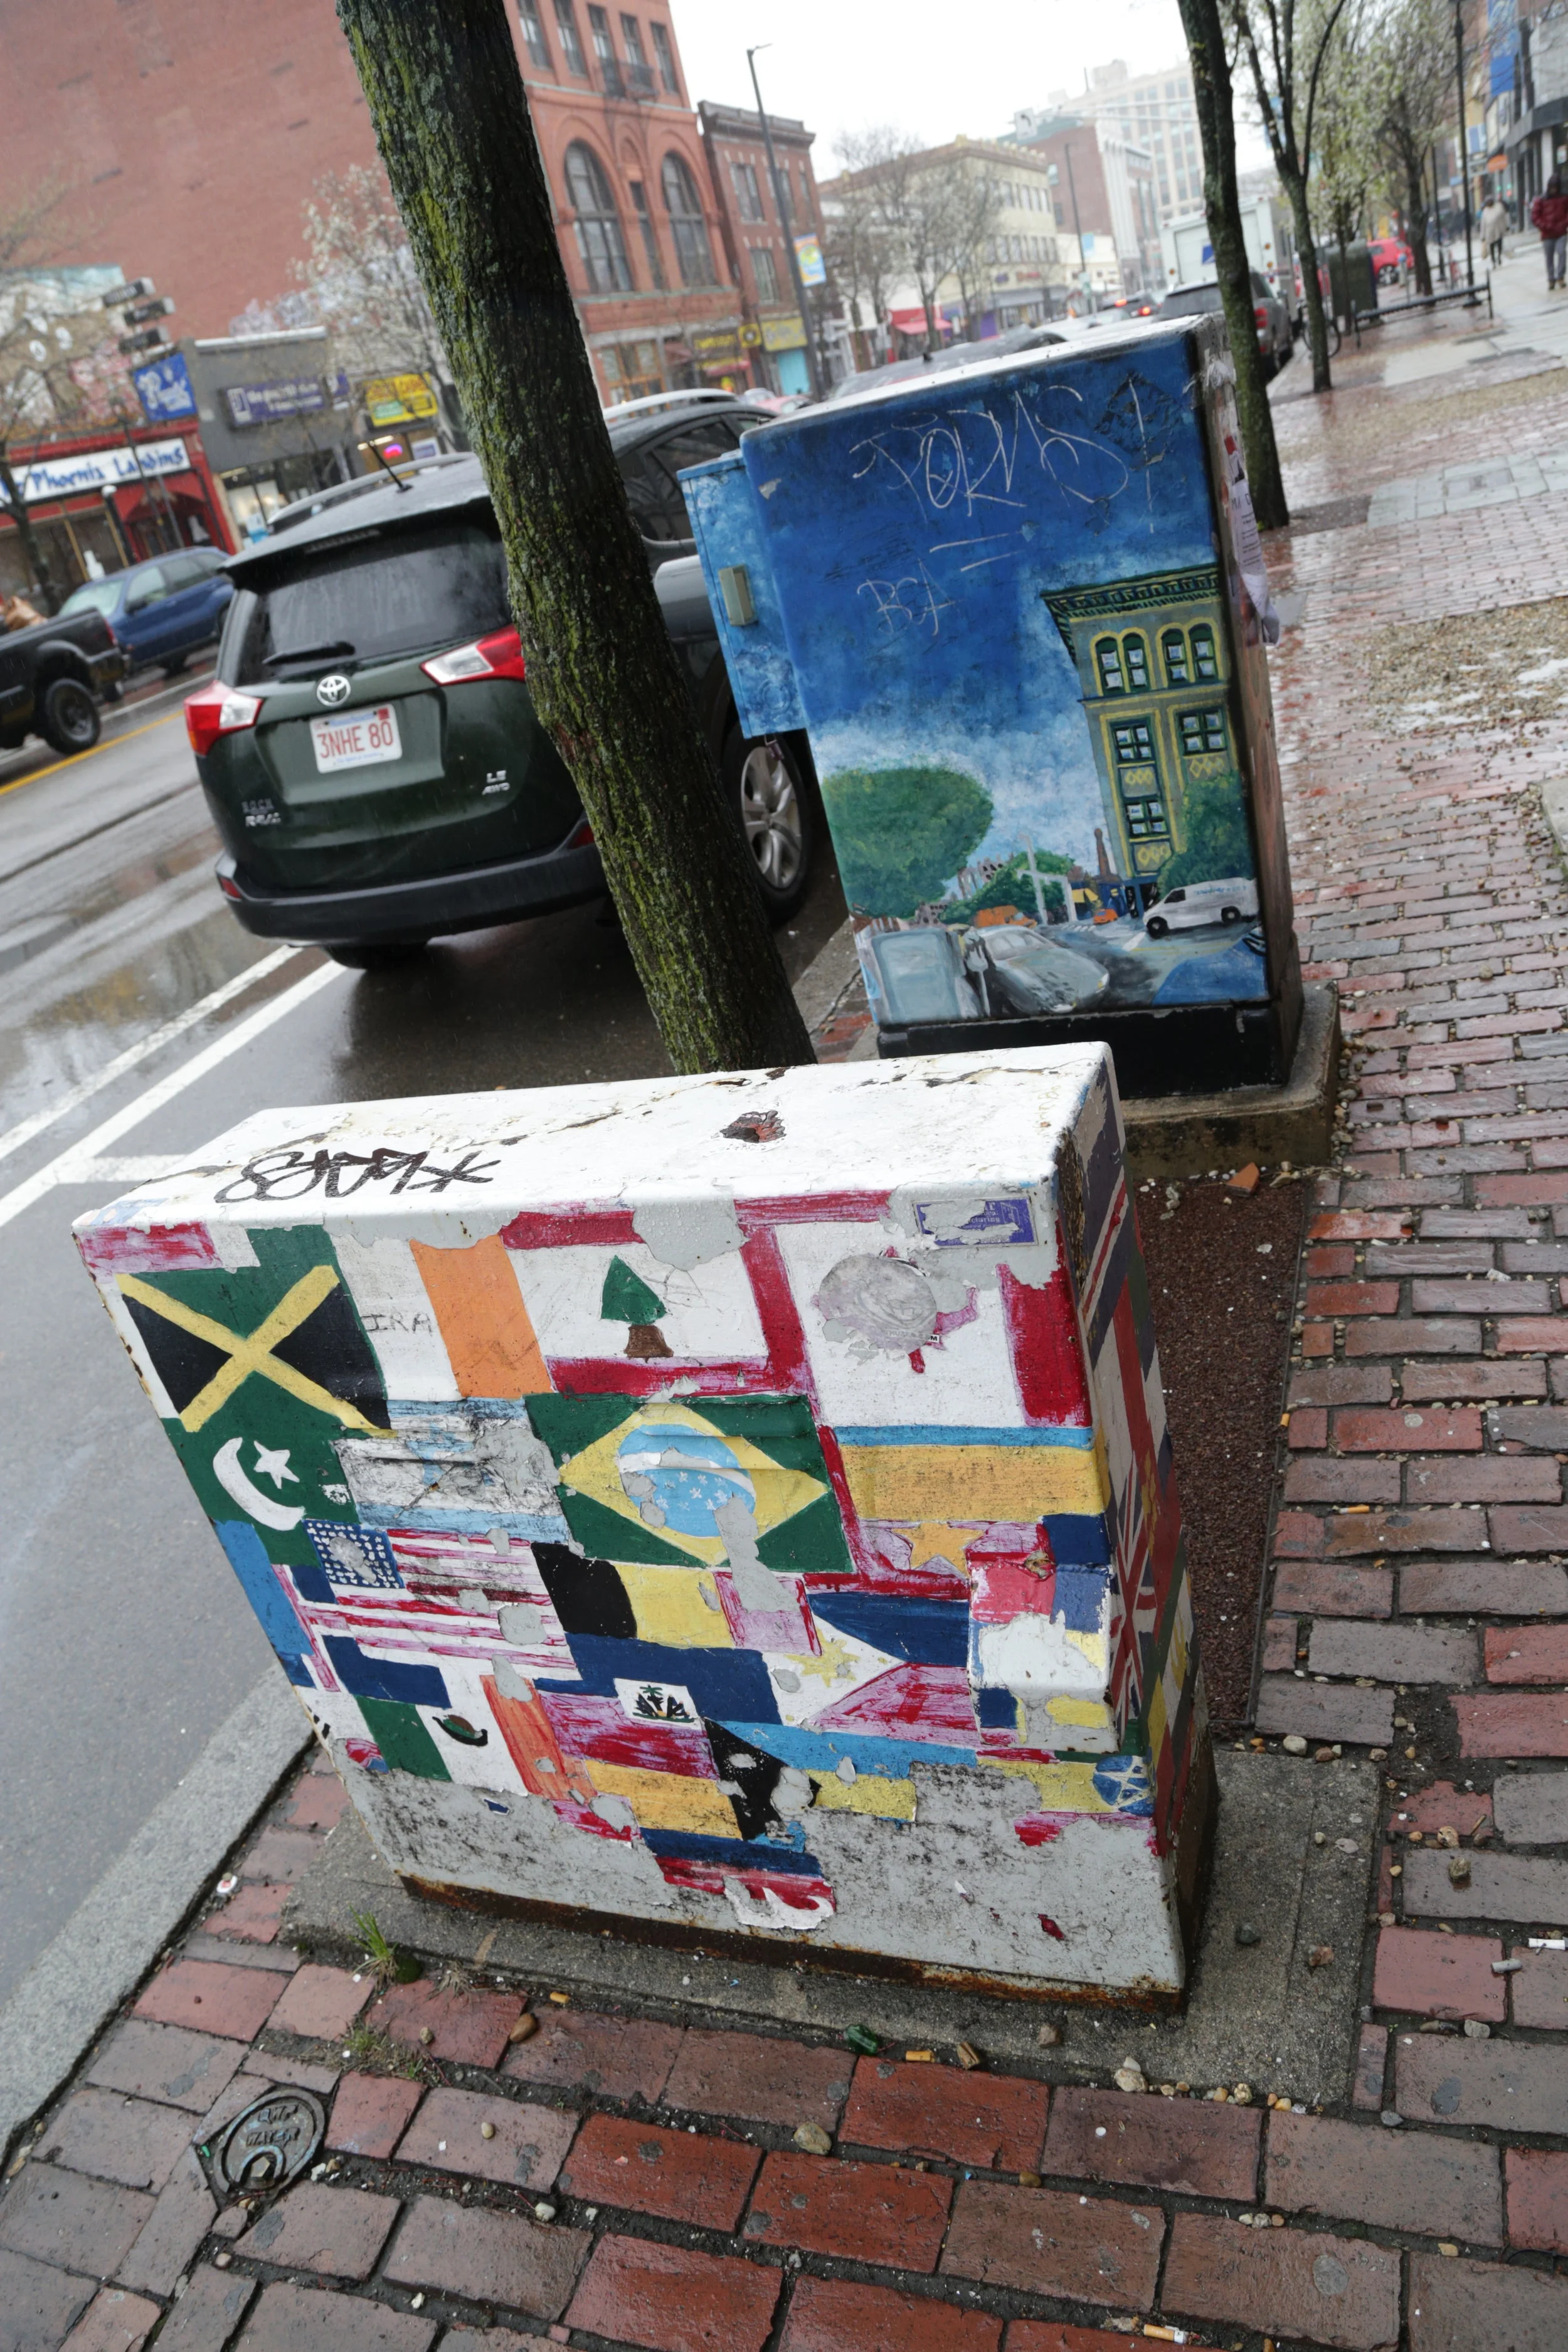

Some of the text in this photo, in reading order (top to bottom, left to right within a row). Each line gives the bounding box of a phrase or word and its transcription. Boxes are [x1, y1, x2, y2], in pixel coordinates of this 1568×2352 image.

[317, 721, 393, 758] 3NHE 80
[487, 770, 506, 783] LE
[361, 1311, 433, 1337] IRA
[246, 2127, 301, 2148] WATER
